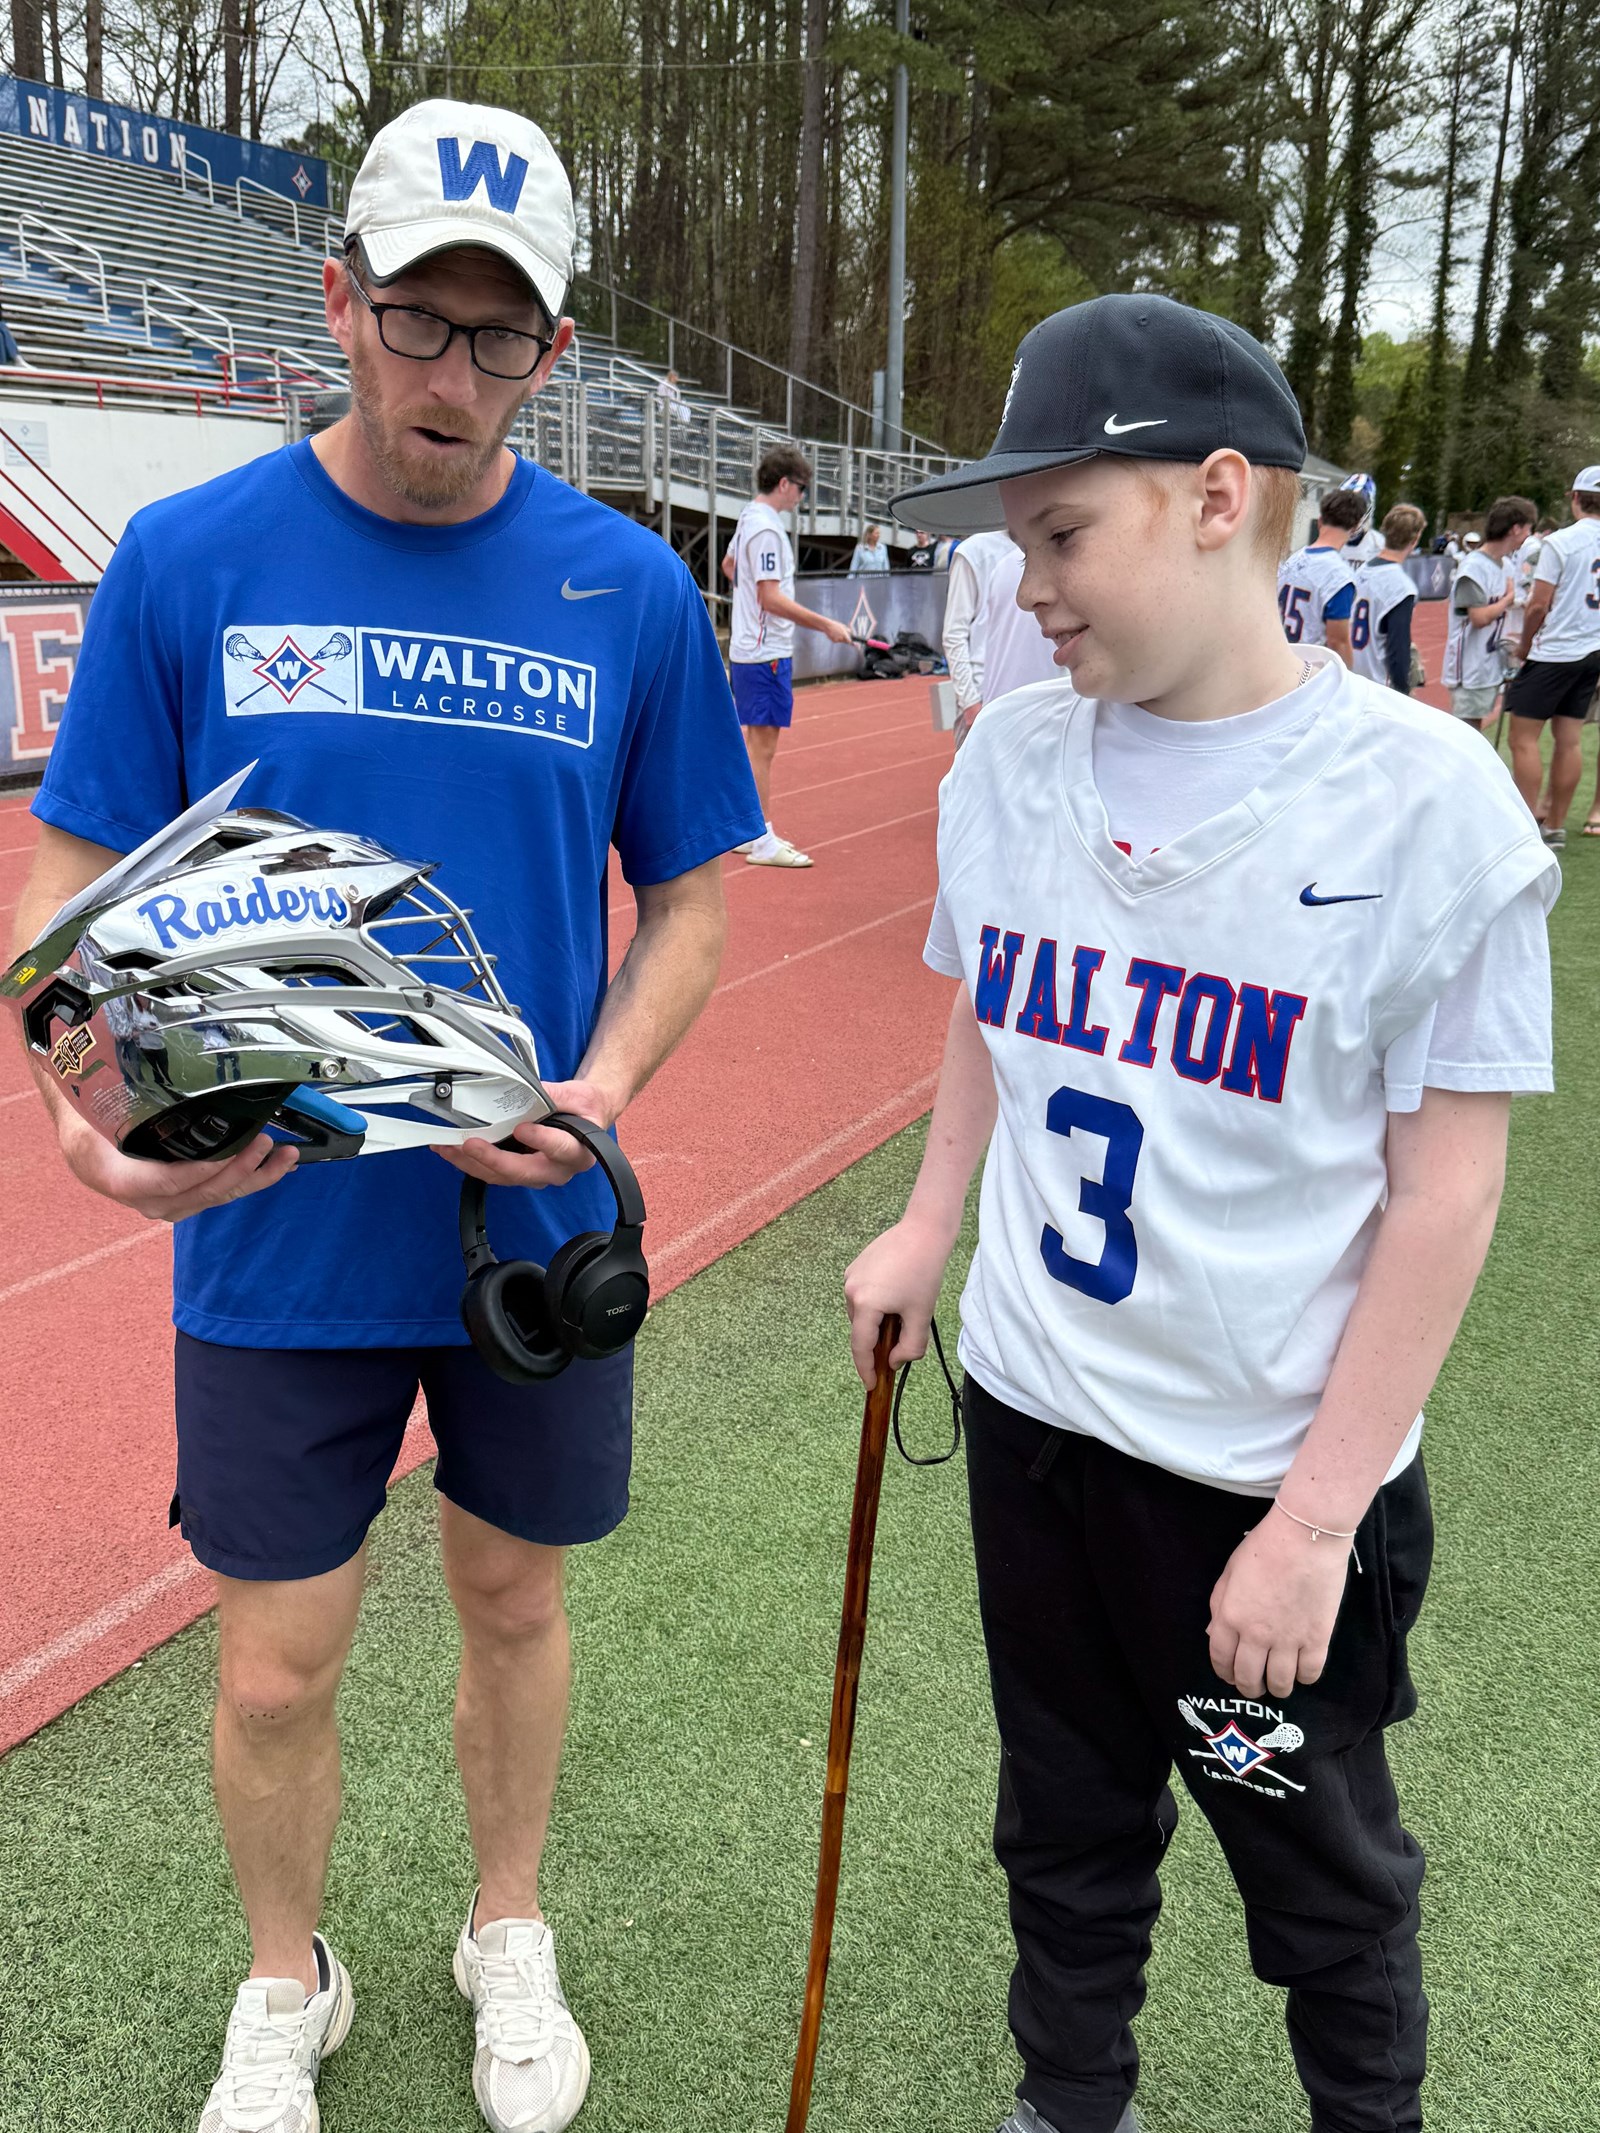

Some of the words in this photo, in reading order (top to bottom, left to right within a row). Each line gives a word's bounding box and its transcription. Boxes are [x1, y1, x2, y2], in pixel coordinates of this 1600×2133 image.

[27, 95, 187, 169] NATION
[436, 136, 530, 215] W
[760, 552, 776, 572] 16
[1, 604, 84, 760] E
[275, 660, 302, 680] W
[369, 638, 587, 710] WALTON
[392, 690, 567, 731] LACROSSE
[136, 876, 348, 949] Raiders
[975, 924, 1308, 1104] WALTON
[1039, 1085, 1145, 1306] 3
[606, 1303, 632, 1317] TOZO
[1185, 1694, 1284, 1724] WALTON
[1220, 1742, 1248, 1764] W
[1202, 1764, 1286, 1799] LACROSSE
